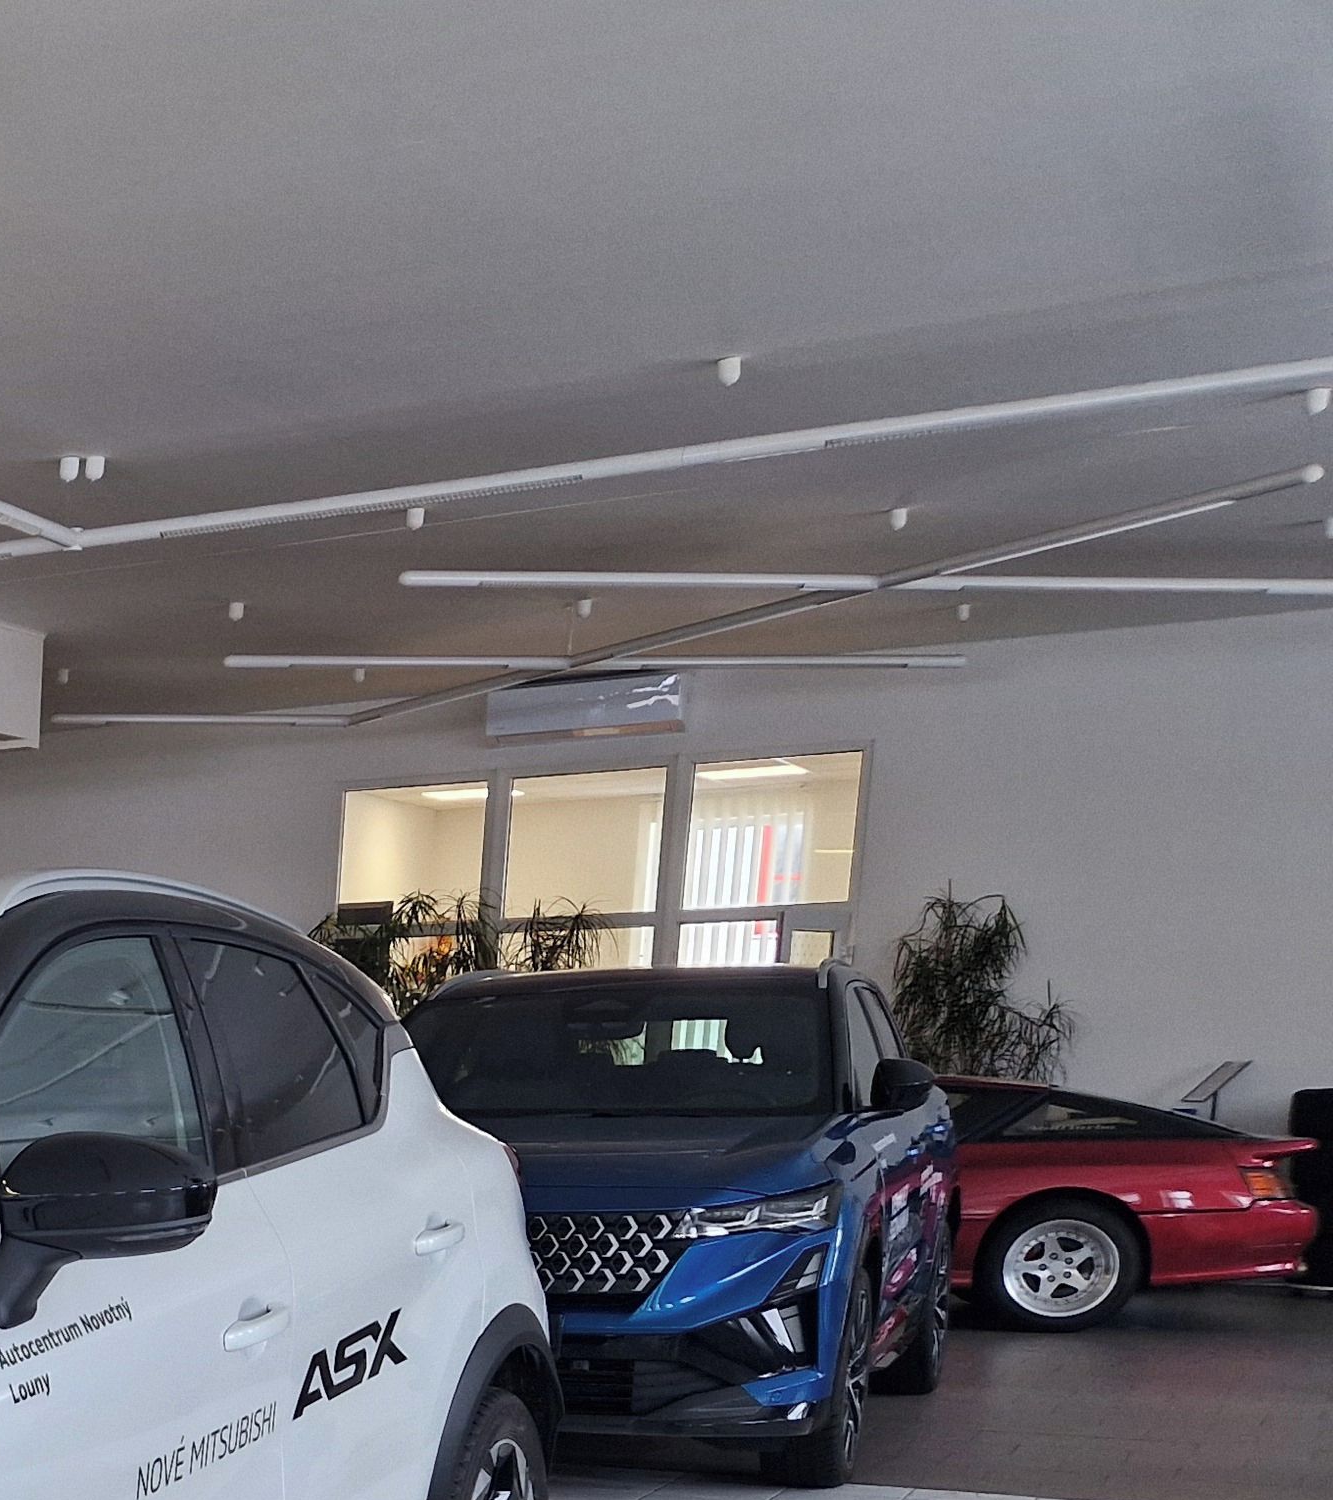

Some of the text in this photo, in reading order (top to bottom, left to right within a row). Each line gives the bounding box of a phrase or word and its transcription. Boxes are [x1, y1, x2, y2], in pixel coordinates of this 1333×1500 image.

[78, 1296, 133, 1334] Novotný
[8, 1373, 51, 1404] Louny
[135, 1307, 408, 1500] NOVÉ MITSUBISHI ASX
